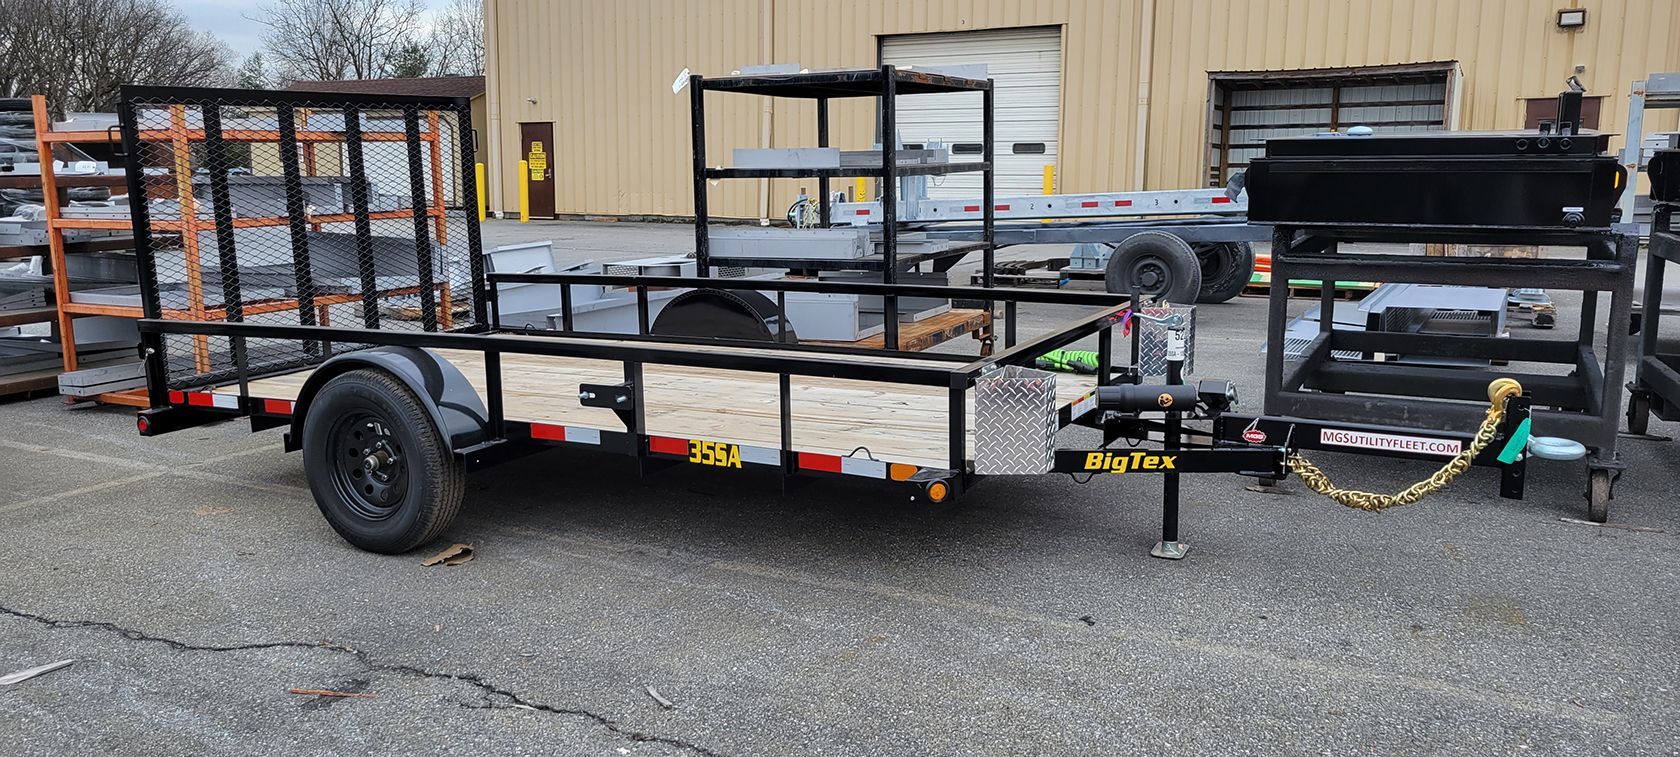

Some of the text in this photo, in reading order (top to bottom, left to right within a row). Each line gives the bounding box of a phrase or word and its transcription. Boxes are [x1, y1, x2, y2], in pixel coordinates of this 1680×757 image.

[689, 439, 743, 469] 35SA
[1322, 430, 1460, 454] MGSUTILITYFLEET.COM
[1083, 452, 1178, 474] BigTex
